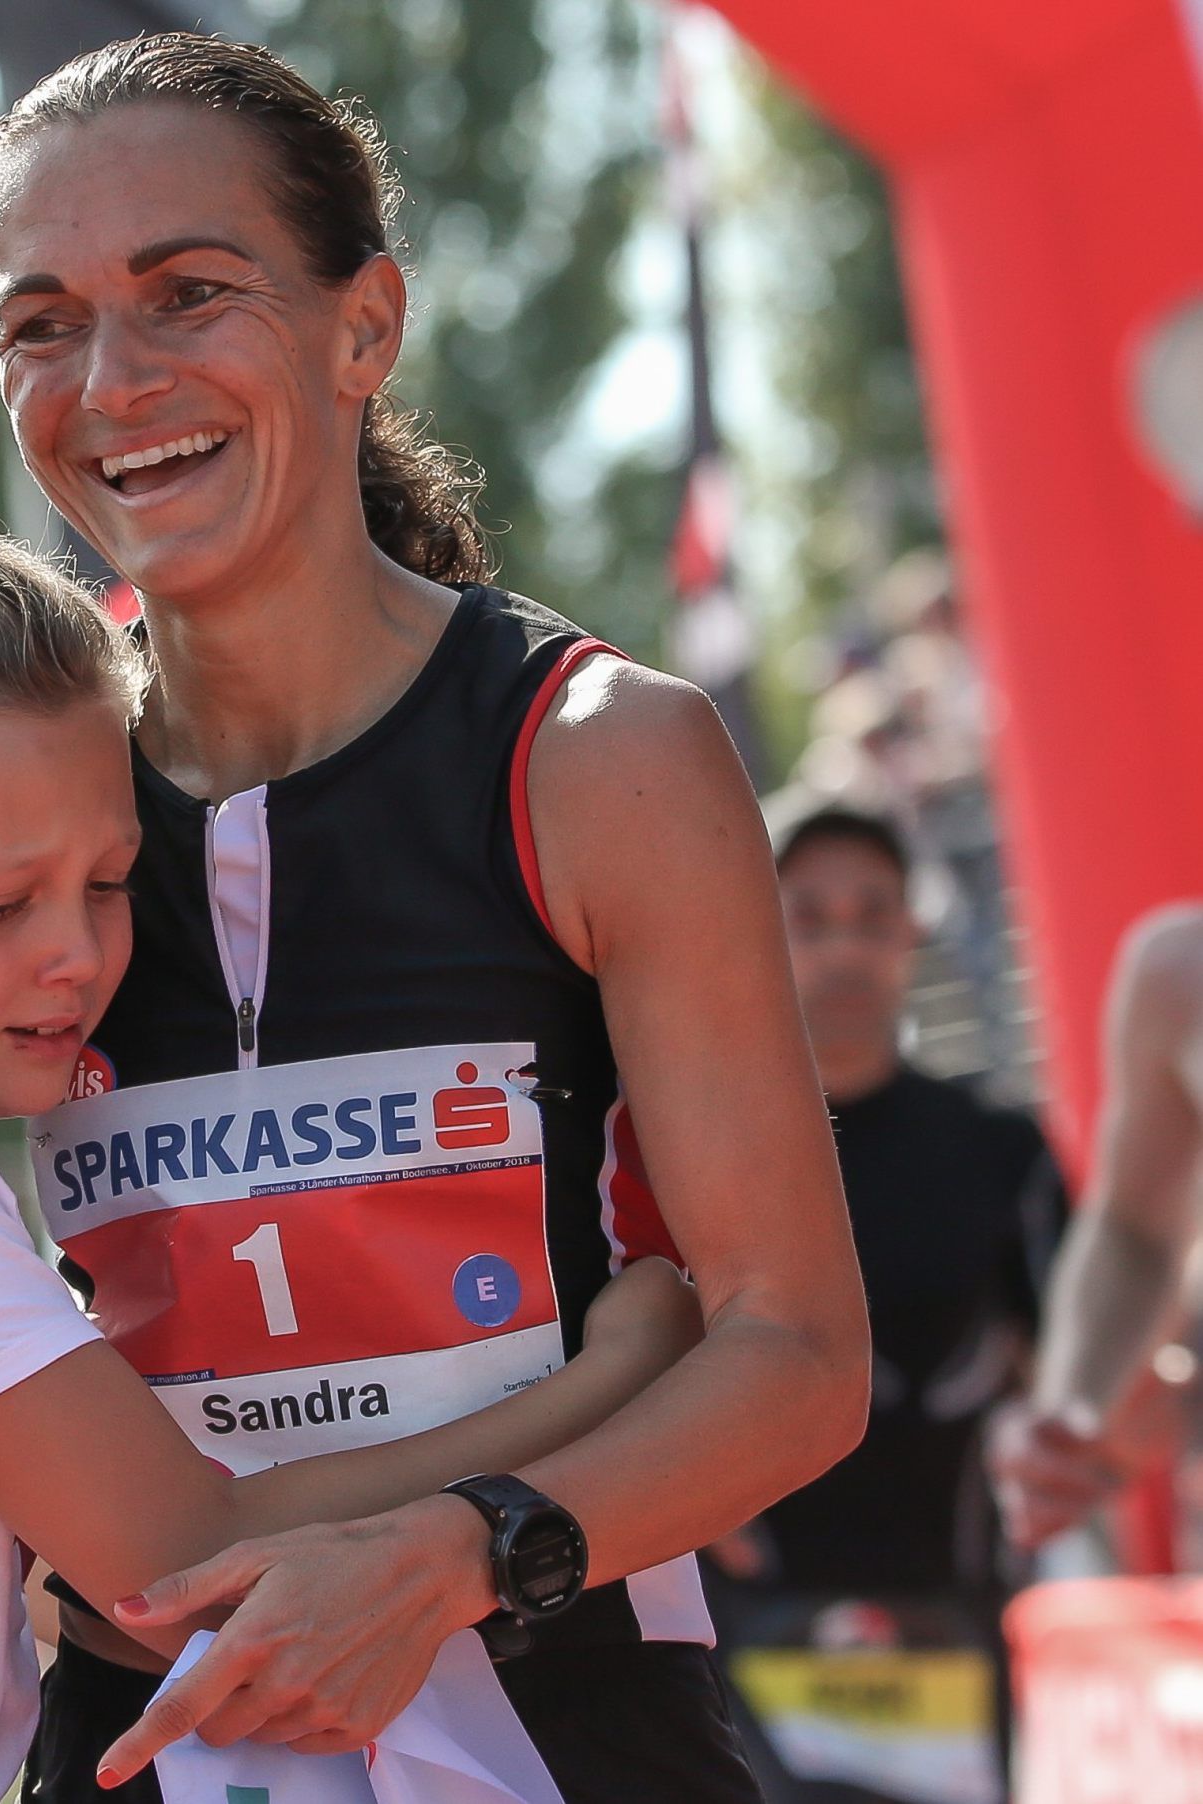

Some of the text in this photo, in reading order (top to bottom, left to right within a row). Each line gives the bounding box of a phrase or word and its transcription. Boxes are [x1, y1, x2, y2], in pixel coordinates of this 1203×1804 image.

[53, 1091, 422, 1212] SPARKASSE
[250, 1184, 297, 1196] Sparkasse
[384, 1172, 400, 1181] am
[465, 1160, 502, 1172] Oktober
[504, 1156, 530, 1167] 2018
[232, 1223, 299, 1336] 1
[476, 1276, 498, 1301] E
[545, 1364, 553, 1376] 1
[201, 1379, 390, 1435] Sandra
